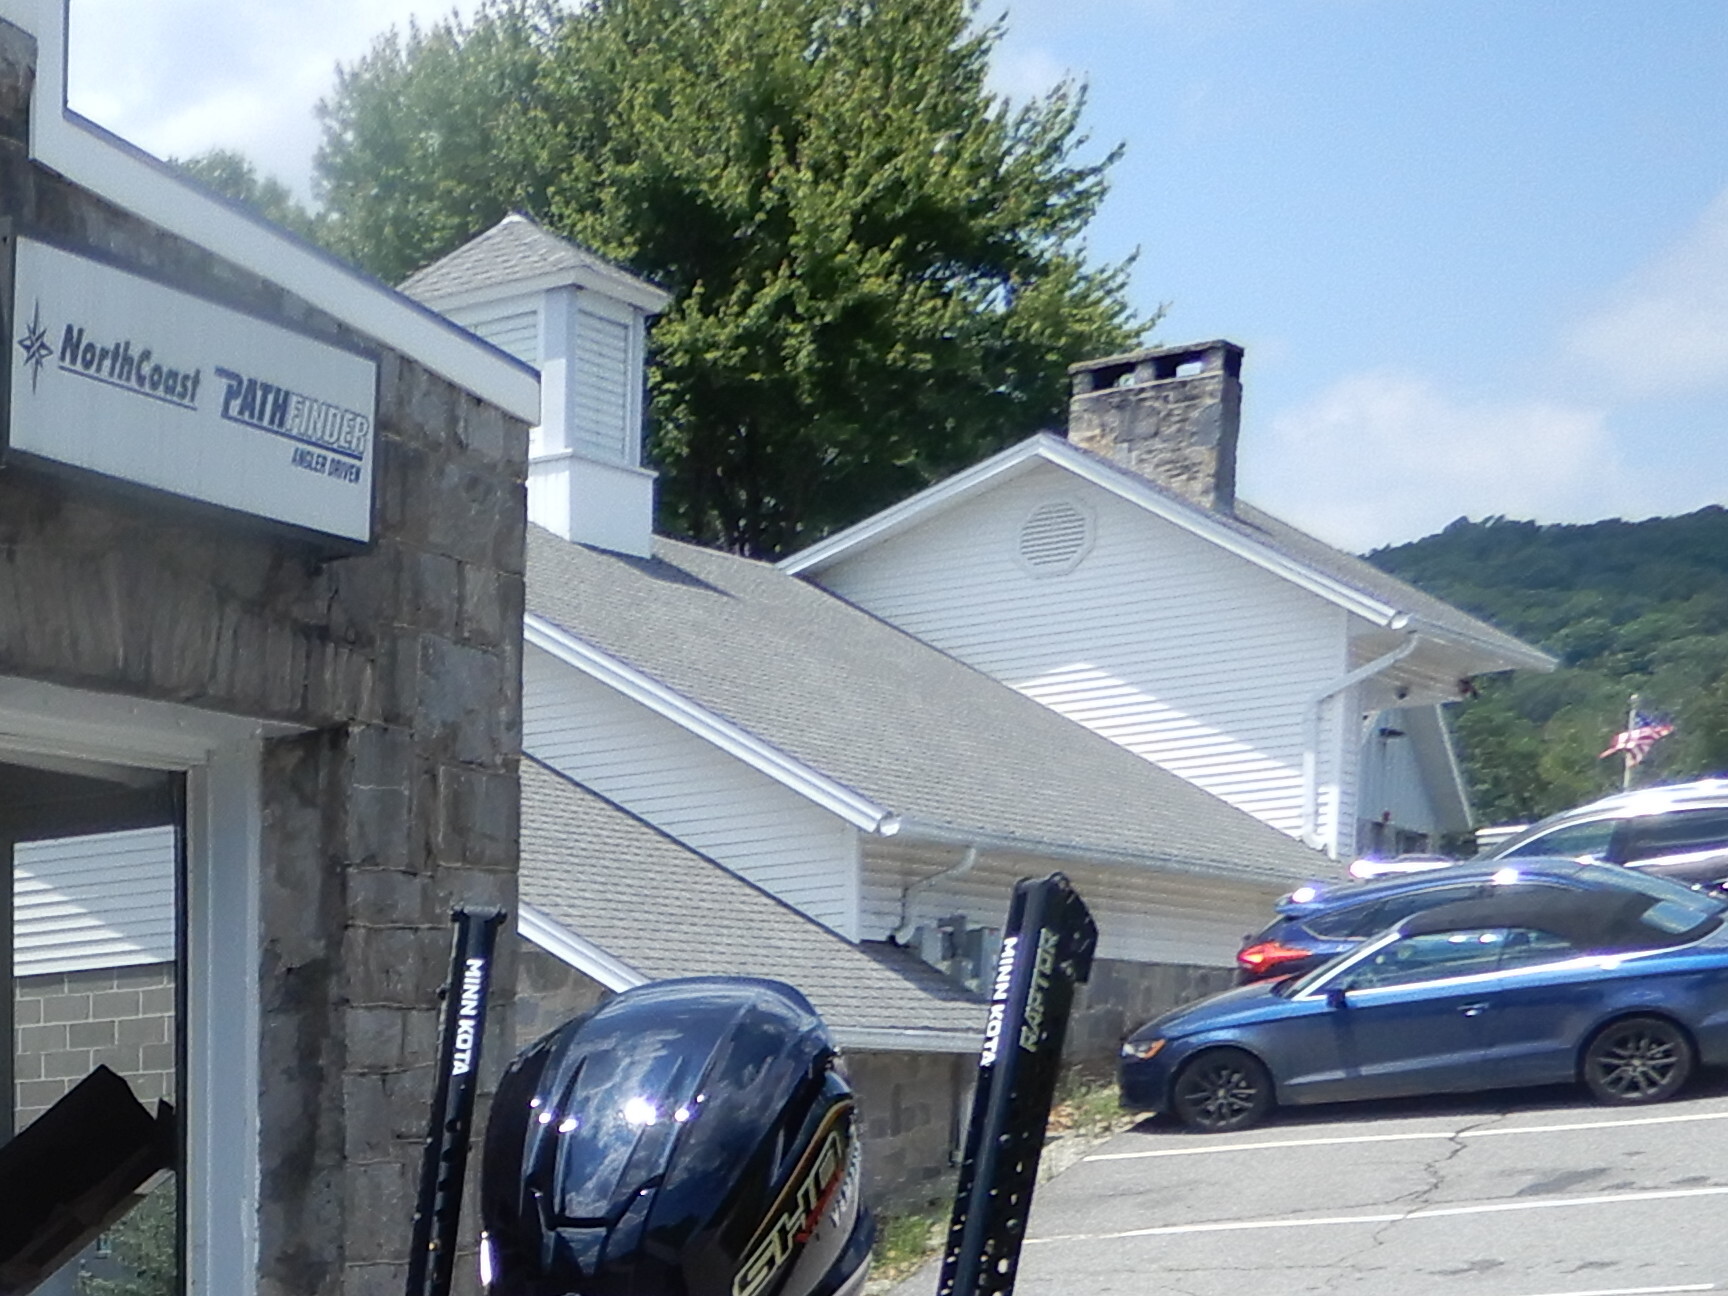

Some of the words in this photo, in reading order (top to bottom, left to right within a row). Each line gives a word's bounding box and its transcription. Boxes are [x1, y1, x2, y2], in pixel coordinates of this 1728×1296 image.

[60, 323, 202, 403] NorthCoast
[215, 366, 371, 456] PATHFINDER
[459, 958, 485, 1016] MINN
[993, 937, 1019, 1001] MINN
[1019, 928, 1060, 1052] RAPTOR
[451, 1018, 476, 1076] KOTA
[979, 1003, 1006, 1067] KOTA
